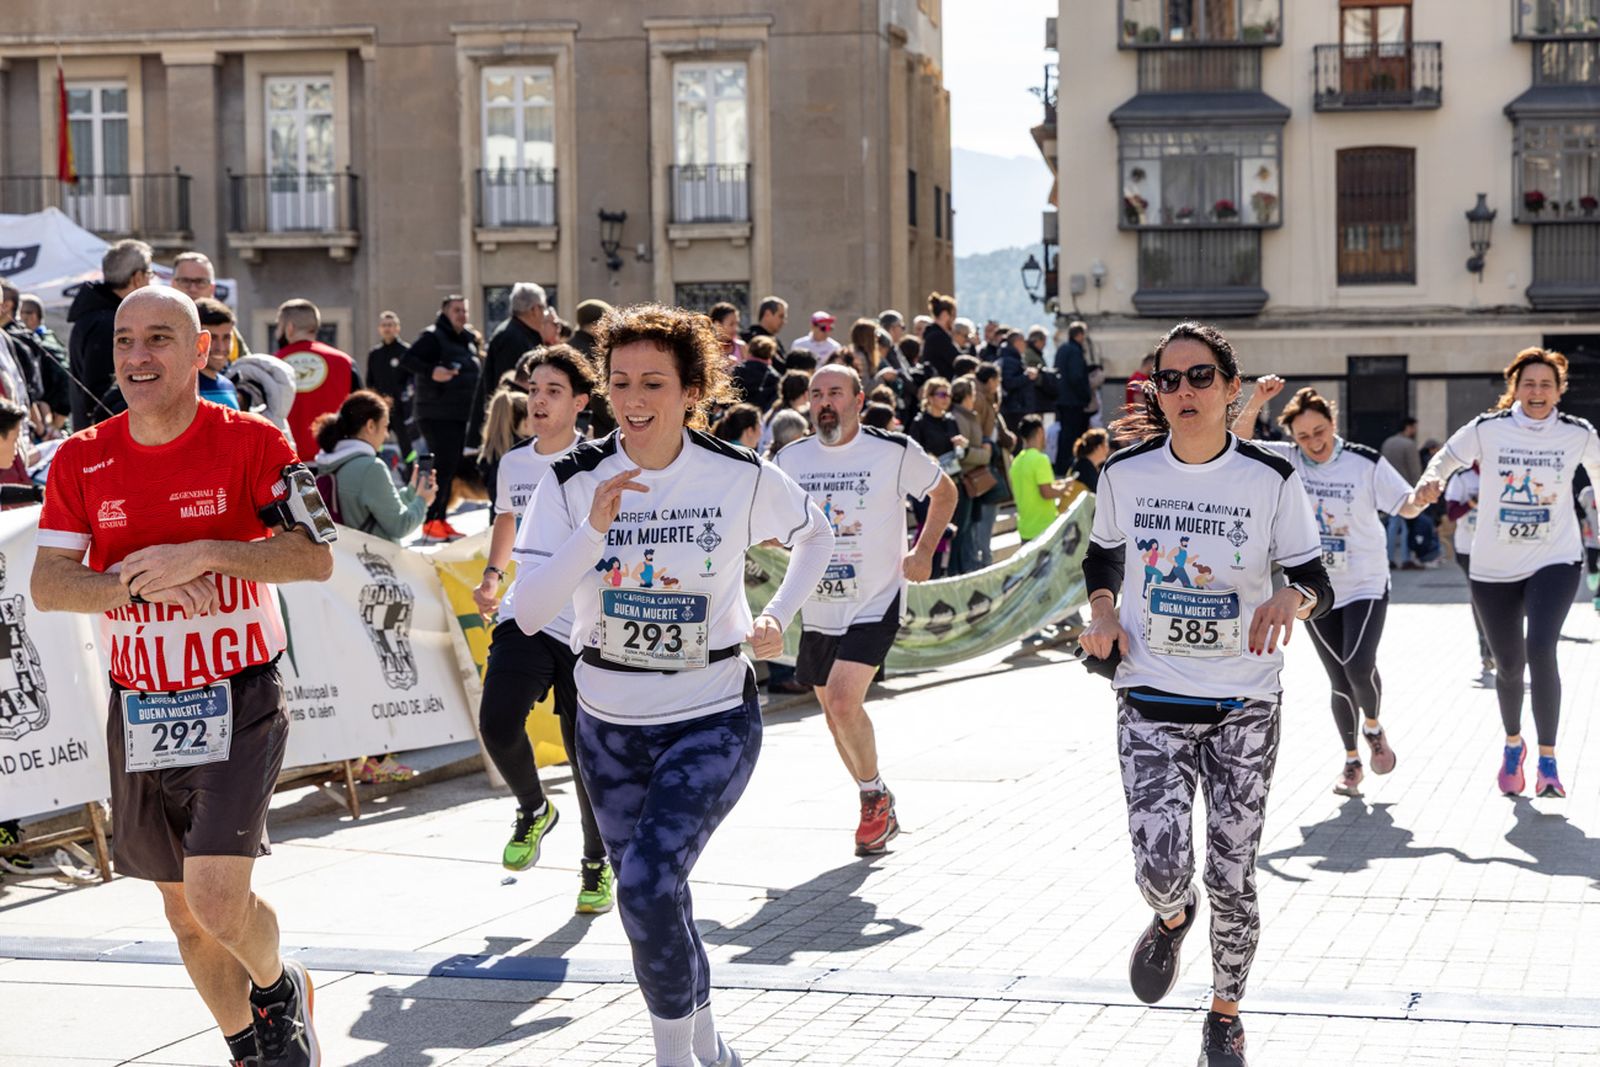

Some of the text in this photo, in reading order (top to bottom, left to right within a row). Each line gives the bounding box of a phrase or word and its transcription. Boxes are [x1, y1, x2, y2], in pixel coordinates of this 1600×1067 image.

[823, 480, 854, 491] MUERTE
[180, 504, 216, 519] MÁLAGA
[613, 507, 722, 523] ARRERA CAMINATA
[1136, 497, 1252, 518] VI CARRERA CAMINATA
[606, 525, 695, 546] ENA MUERTE
[1134, 513, 1226, 537] BUENA MUERTE
[1508, 523, 1539, 537] 627
[613, 592, 696, 605] VI CARRERA CAMINATA
[1159, 601, 1217, 617] BUENA MUERTE
[613, 602, 678, 620] BUENA MUERTE
[623, 621, 683, 653] 293
[1167, 618, 1219, 645] 585
[111, 622, 269, 691] MÁLAGA
[139, 703, 203, 721] BUENA MUERTE
[372, 700, 409, 719] CIUDAD
[409, 698, 422, 714] DE
[151, 719, 207, 753] 292
[19, 749, 44, 771] DE
[48, 737, 90, 767] JAÉN
